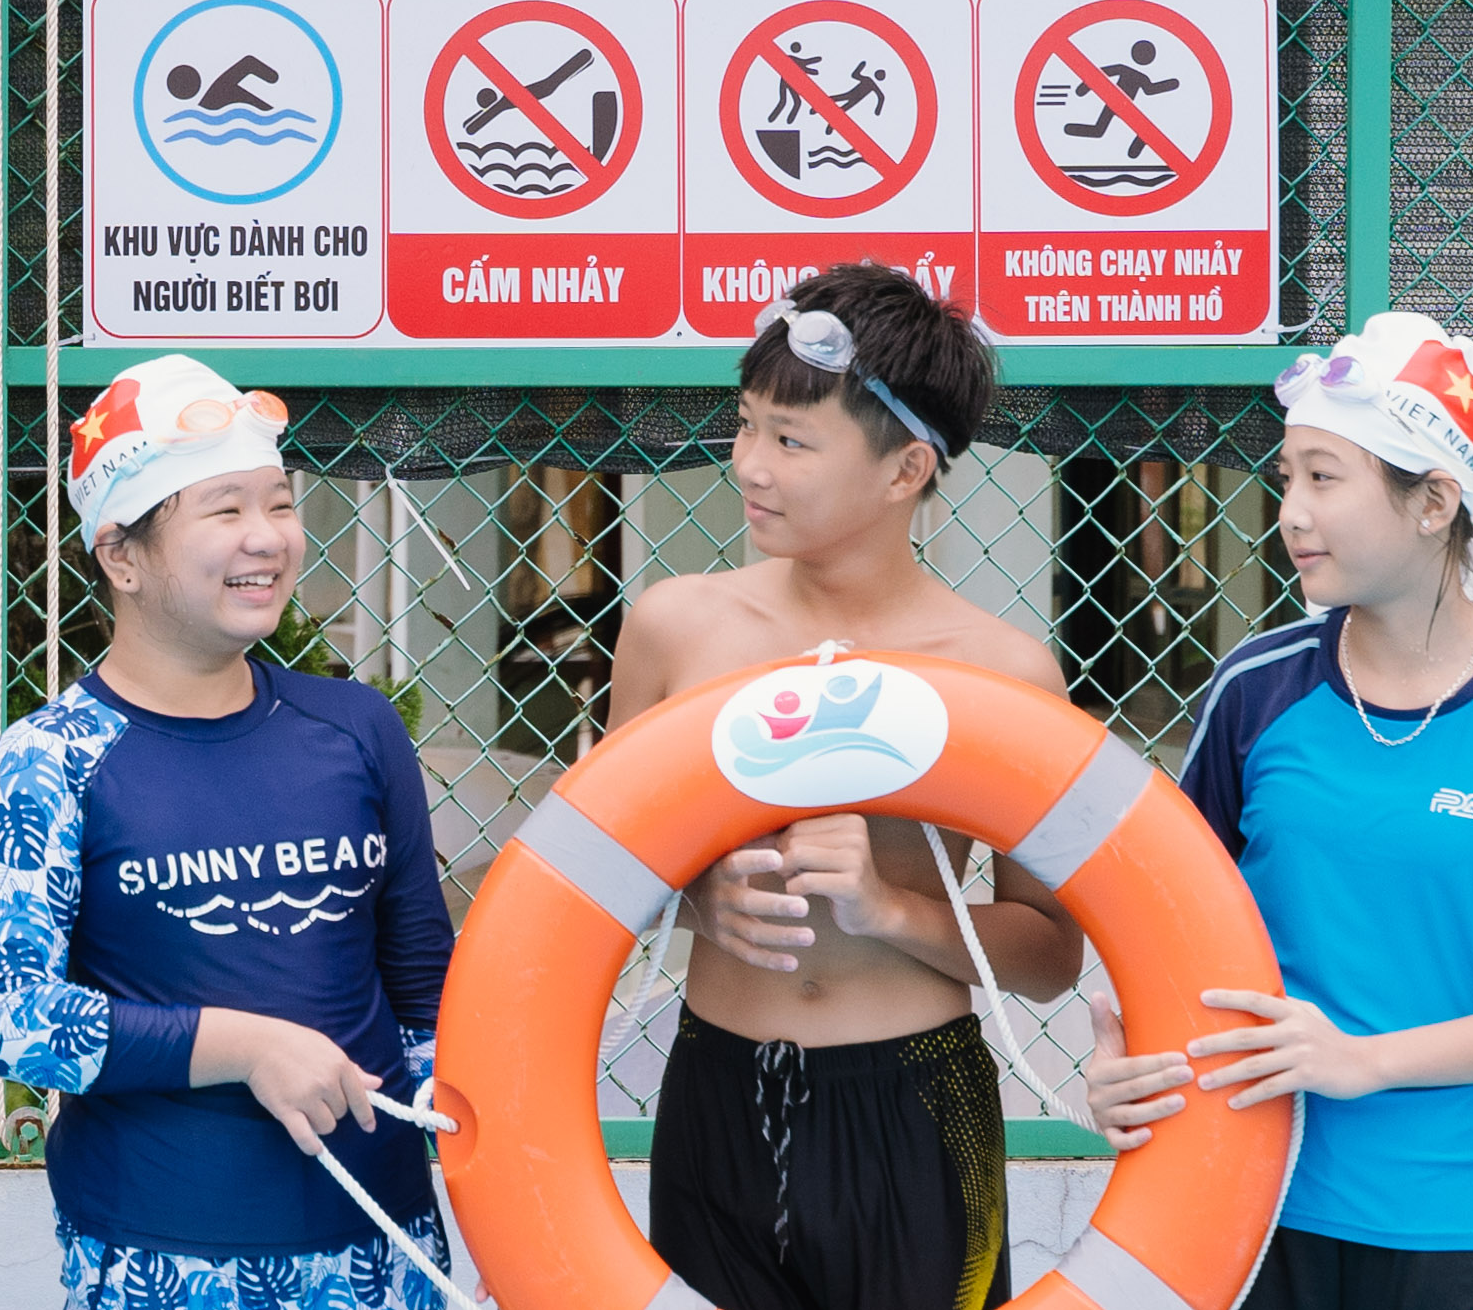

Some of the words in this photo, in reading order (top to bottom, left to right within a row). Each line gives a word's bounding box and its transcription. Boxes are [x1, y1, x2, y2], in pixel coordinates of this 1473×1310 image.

[104, 225, 158, 257] KHU
[167, 222, 221, 264] VỰC
[230, 219, 305, 257] DÀNH
[314, 225, 369, 257] CHO
[1005, 244, 1093, 278] KHÔNG
[1100, 249, 1167, 282] CHẠY
[1174, 240, 1243, 276] NHẢY
[133, 273, 217, 312] NGƯỜI
[226, 271, 285, 312] BIẾT
[294, 278, 339, 312] BƠI
[442, 254, 521, 304] CẤM
[531, 255, 625, 304] NHẢY
[1024, 290, 1090, 322] TRÊN
[1097, 289, 1182, 322] THÀNH
[1189, 285, 1223, 322] HỒ
[118, 844, 265, 895] SUNNY
